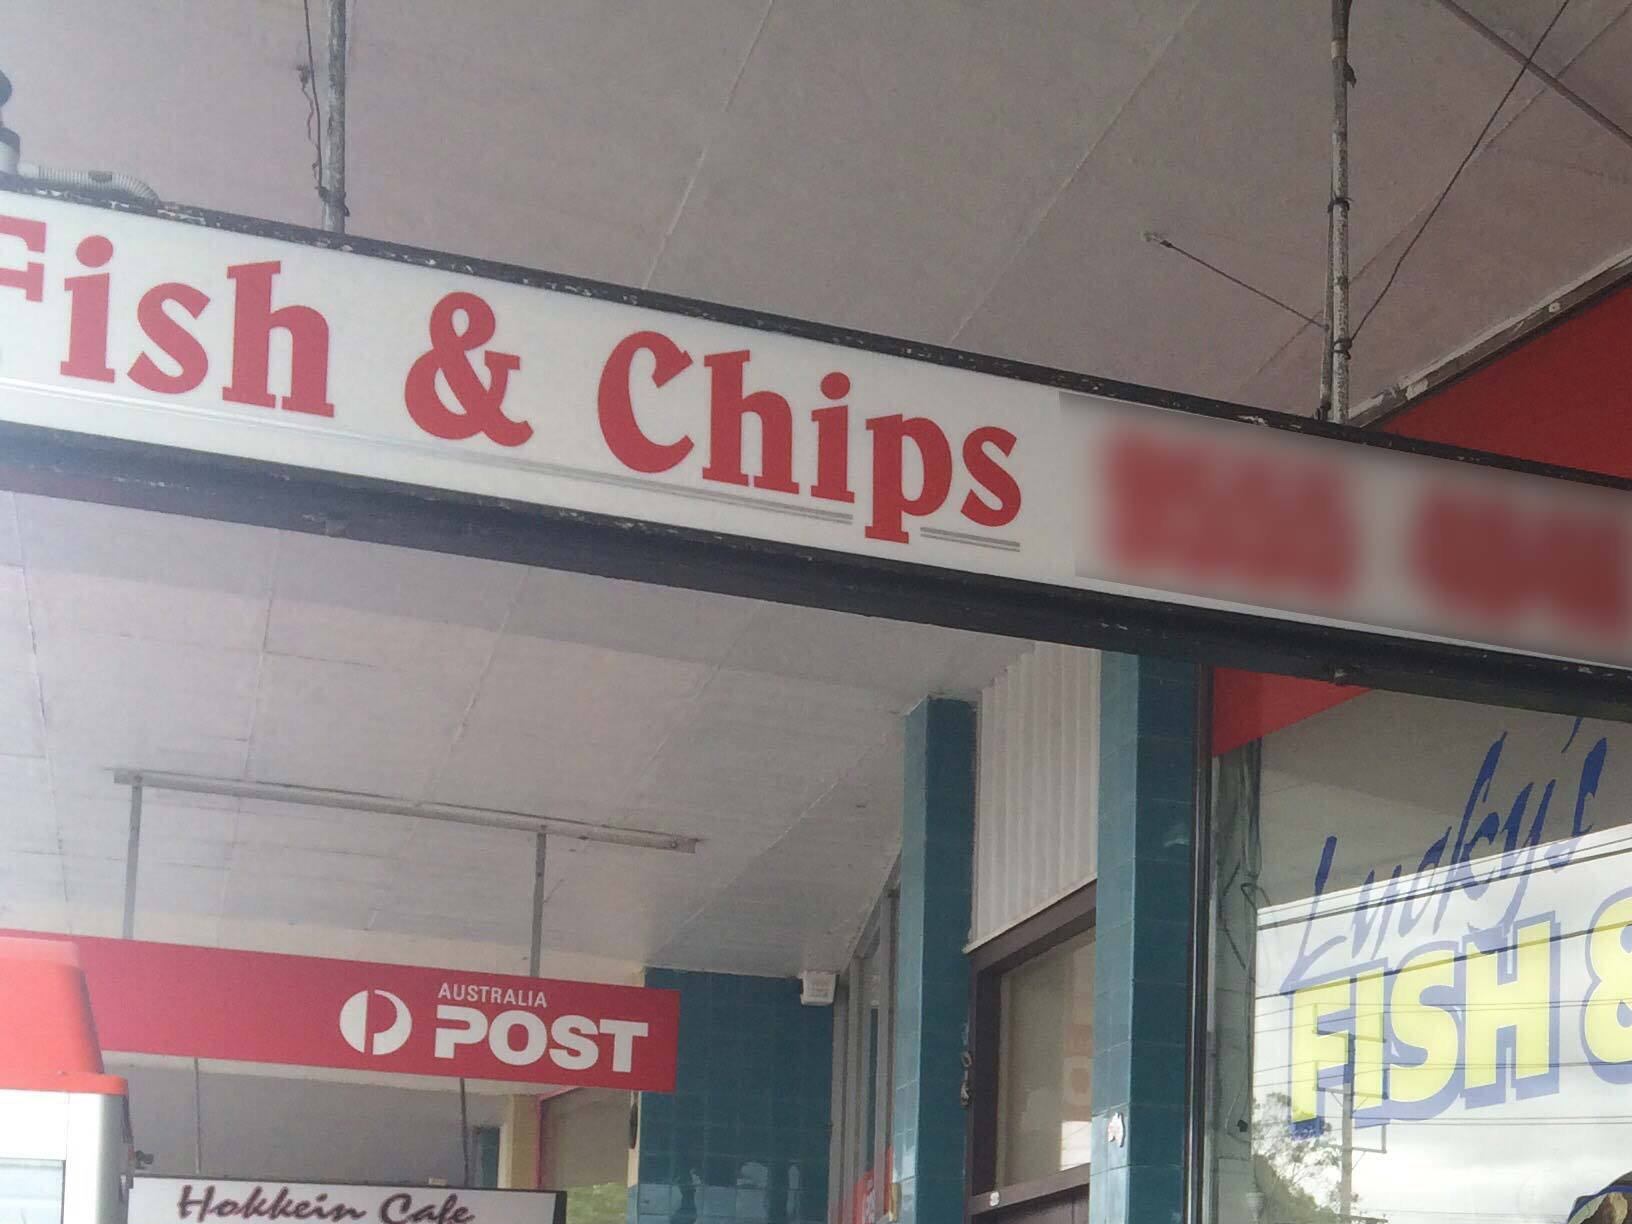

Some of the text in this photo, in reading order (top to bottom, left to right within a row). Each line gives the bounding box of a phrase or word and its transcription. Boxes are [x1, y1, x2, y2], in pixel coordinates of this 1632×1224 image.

[404, 291, 534, 447] &
[598, 330, 1022, 542] Chips
[438, 982, 548, 1008] AUSTRALIA
[1284, 911, 1561, 1138] FISH
[434, 1004, 649, 1073] POST
[177, 1184, 367, 1222] Hokkein
